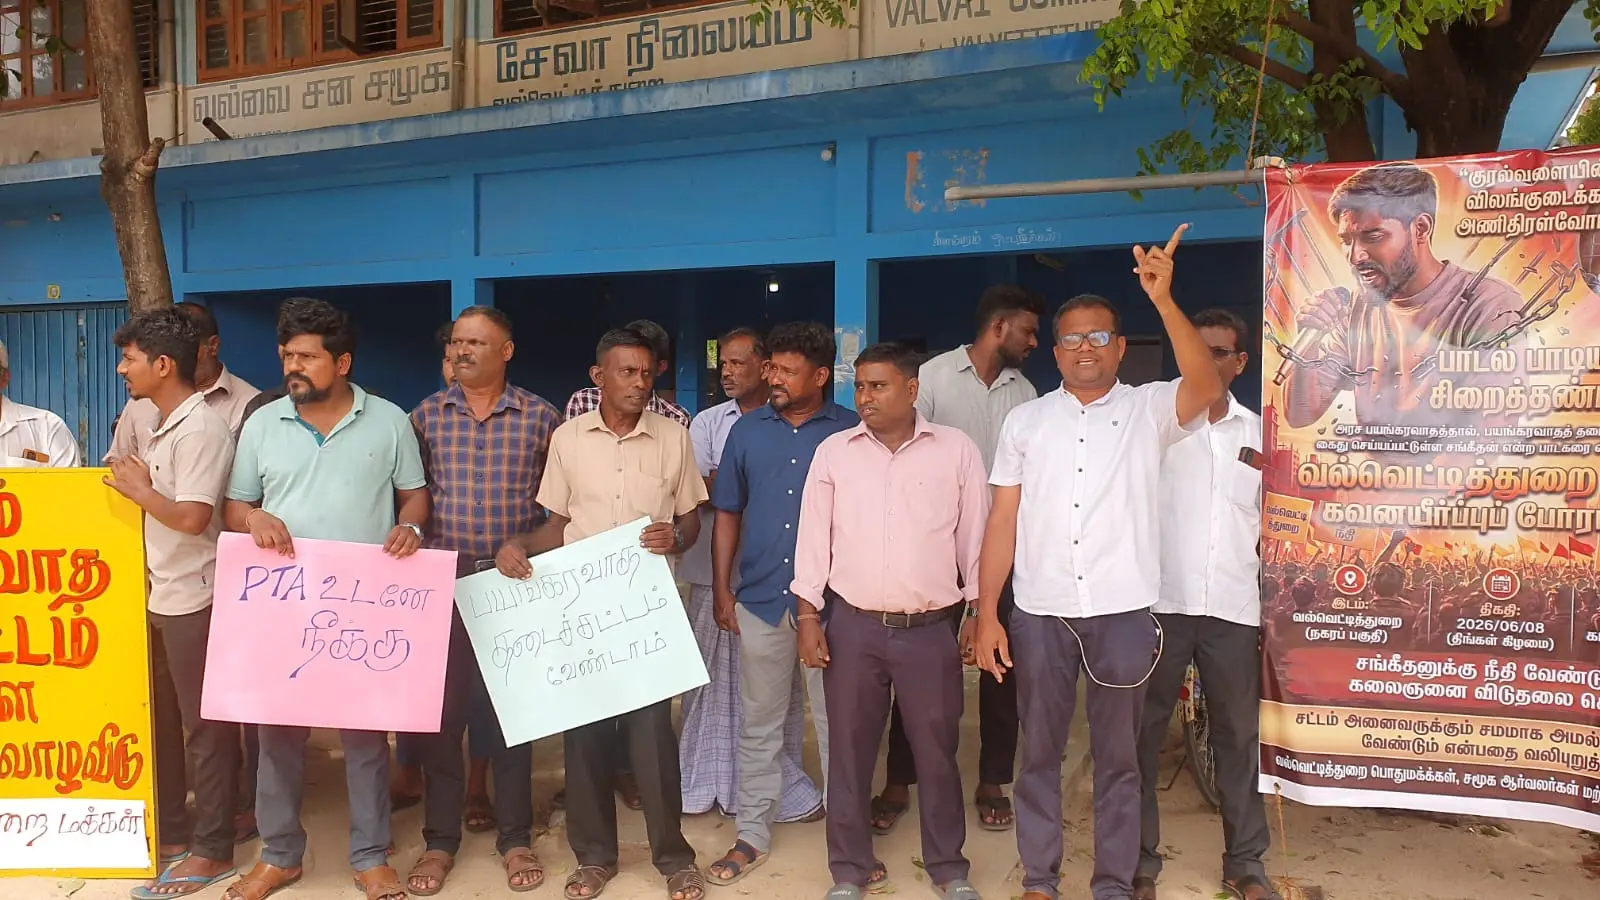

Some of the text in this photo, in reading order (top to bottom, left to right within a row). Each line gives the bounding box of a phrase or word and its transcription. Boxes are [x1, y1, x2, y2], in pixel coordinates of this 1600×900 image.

[496, 36, 612, 84] சேவா
[1439, 341, 1517, 373] பாடல்
[1430, 377, 1600, 417] சிறைத்தண்
[1335, 424, 1362, 436] அரச
[1316, 440, 1348, 452] கைது
[1503, 442, 1535, 455] என்ற
[1539, 443, 1590, 455] பாடகரை
[1298, 456, 1597, 501] வல்வெட்டித்துறை
[1517, 501, 1600, 535] போர
[239, 564, 306, 600] PTA
[1331, 597, 1369, 610] இடம்:
[1480, 602, 1521, 617] திகதி:
[1293, 611, 1402, 629] வல்வெட்டித்துறை
[1456, 618, 1545, 633] 2026/06/08
[1305, 627, 1388, 644] (நகரப் பகுதி)
[1447, 632, 1497, 647] (திங்கள்
[1356, 653, 1478, 680] சங்கீதனுக்கு
[1484, 659, 1517, 682] நீதி
[1474, 682, 1574, 706] விடுதலை
[1295, 710, 1338, 727] சட்டம்
[1344, 714, 1474, 737] அனைவருக்கும்
[1480, 724, 1543, 741] சமமாக
[1361, 733, 1439, 755] வேண்டும்
[1444, 740, 1518, 762] என்பதை
[1276, 755, 1367, 780] வல்வெட்டித்துறை
[1464, 772, 1497, 788] சமூக
[1500, 773, 1580, 797] ஆர்வலர்கள்
[58, 806, 142, 836] மக்கள்
